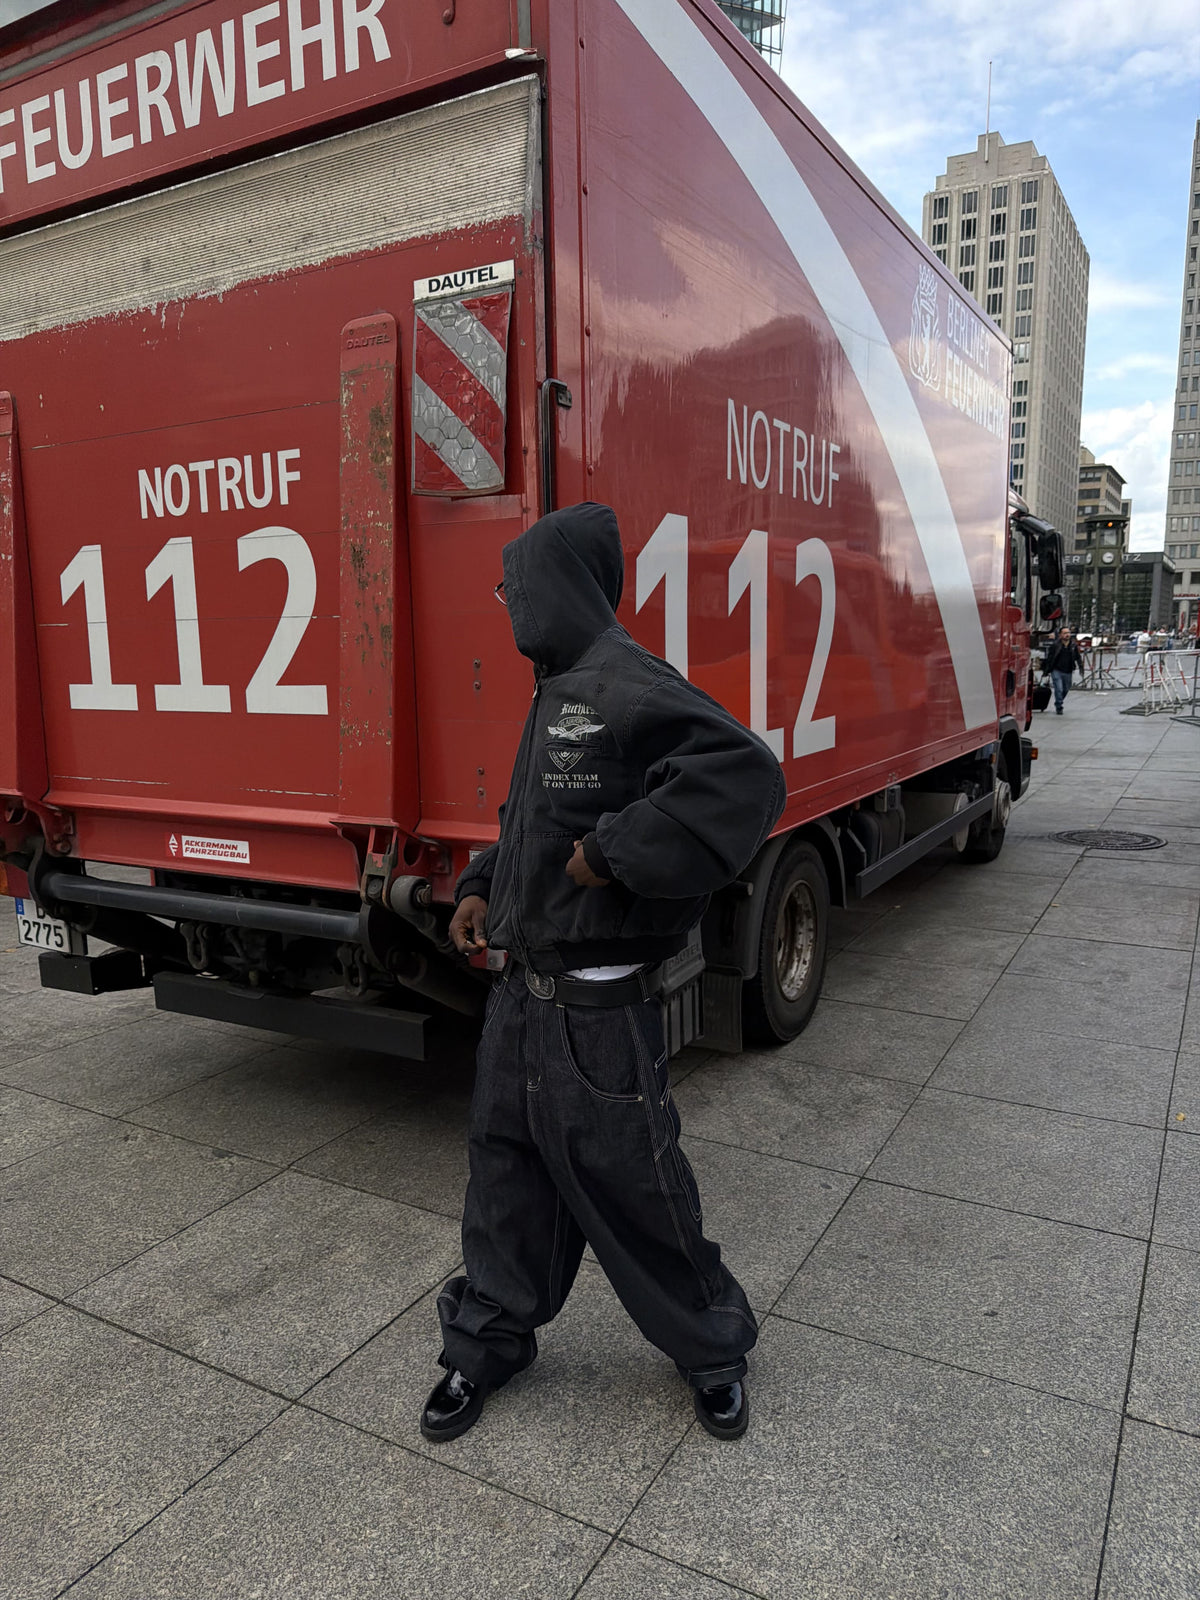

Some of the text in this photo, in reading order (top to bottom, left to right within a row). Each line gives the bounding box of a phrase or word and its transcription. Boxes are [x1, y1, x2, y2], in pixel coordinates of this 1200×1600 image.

[0, 0, 391, 194] FEUERWEHR
[428, 266, 499, 293] DAUTEL
[346, 333, 392, 350] DAUTEL
[946, 294, 991, 374] BERLINER
[945, 347, 1005, 440] FEUERWEHR
[138, 448, 301, 519] NOTRUF
[727, 398, 840, 508] NOTRUF
[60, 526, 329, 716] 112
[635, 512, 836, 763] 112
[567, 781, 586, 789] THE
[588, 781, 601, 789] GO
[185, 840, 238, 851] ACKERMANN
[185, 846, 248, 859] FAHRZEUGBAU
[22, 920, 64, 948] 2775
